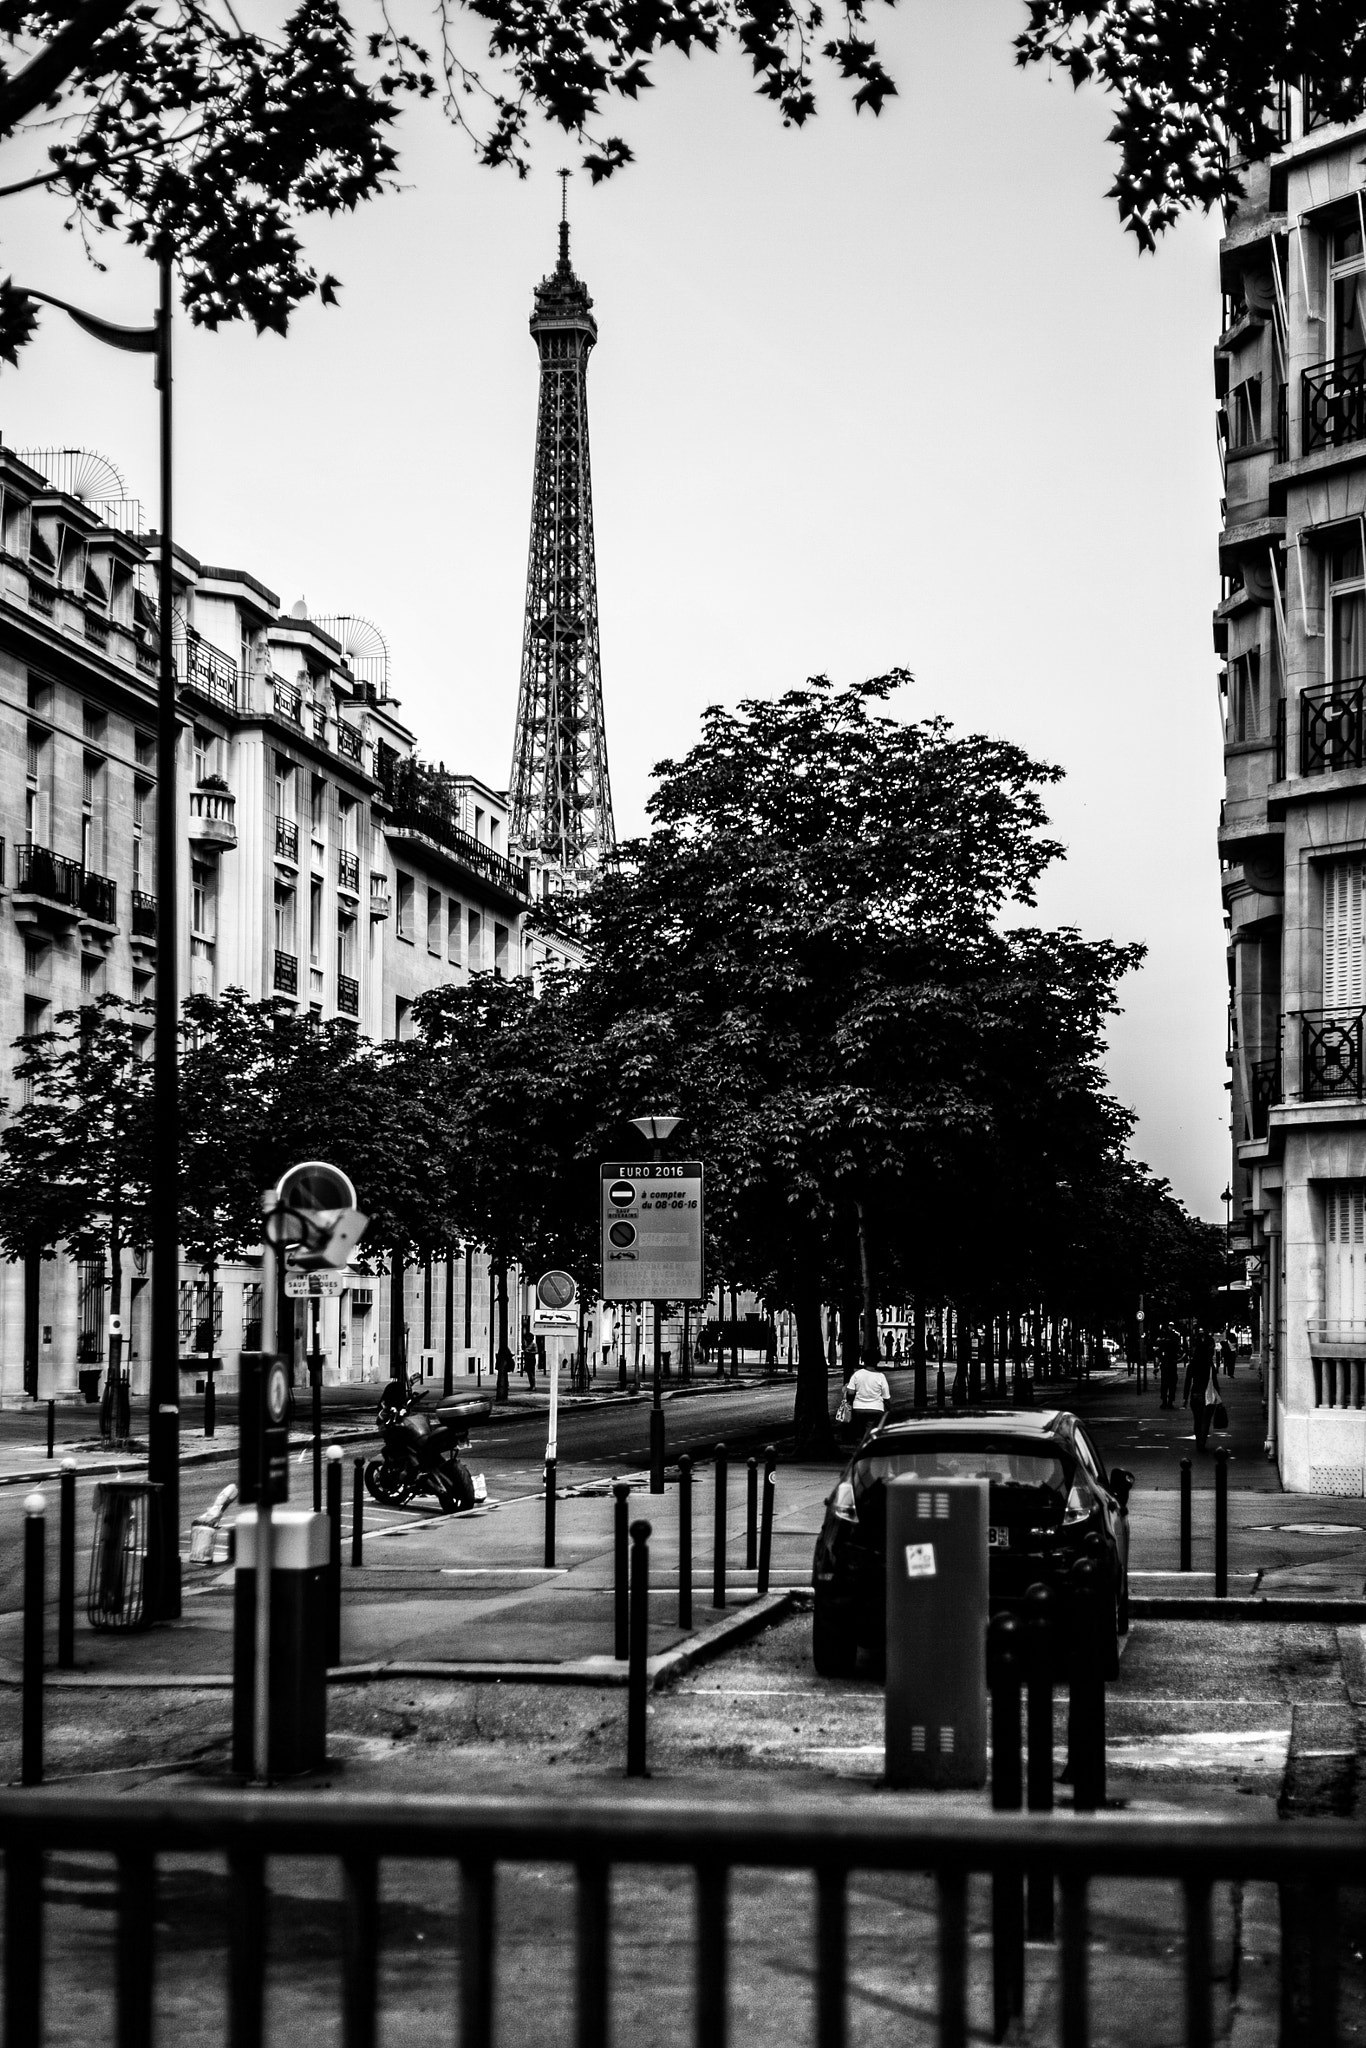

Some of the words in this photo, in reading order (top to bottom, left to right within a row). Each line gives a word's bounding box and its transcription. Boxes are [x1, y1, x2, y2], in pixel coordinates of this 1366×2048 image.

[620, 1167, 650, 1177] EURO
[655, 1166, 684, 1176] 2016
[641, 1190, 647, 1199] à
[650, 1191, 686, 1200] compter
[655, 1200, 698, 1209] 08-06-16
